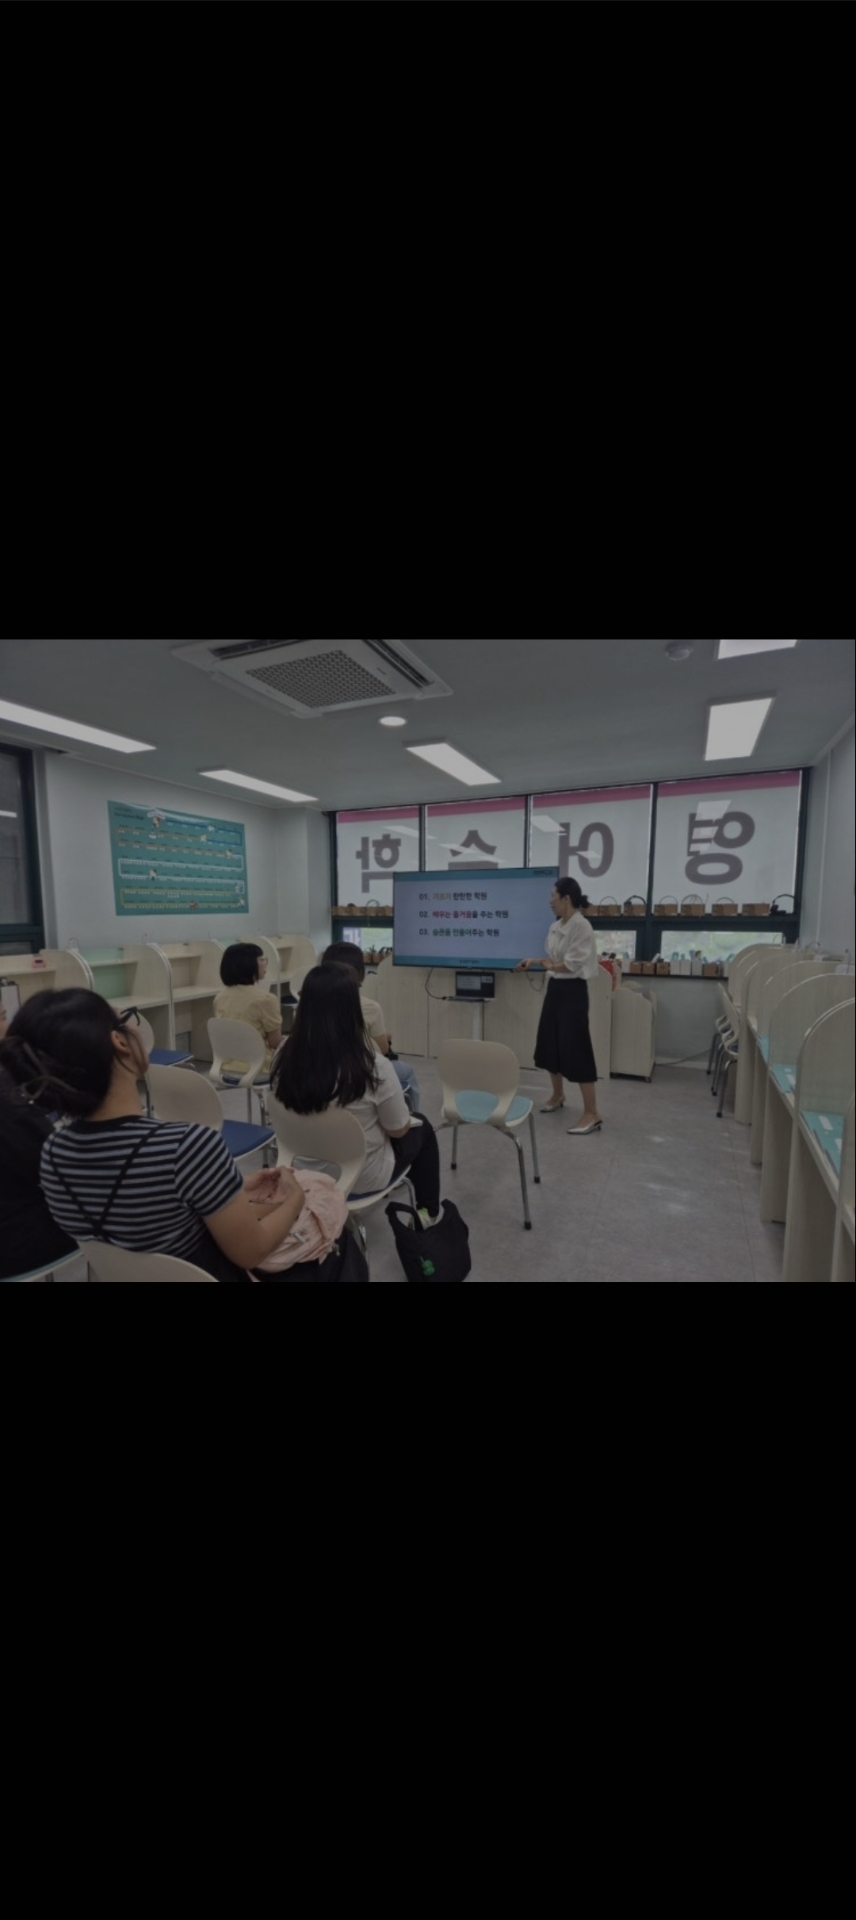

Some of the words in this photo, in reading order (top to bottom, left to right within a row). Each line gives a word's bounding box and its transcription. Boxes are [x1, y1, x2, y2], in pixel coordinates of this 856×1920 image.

[474, 892, 487, 900] 학원
[432, 910, 451, 918] 배우는
[495, 910, 509, 918] 학원
[486, 928, 500, 937] 학원
